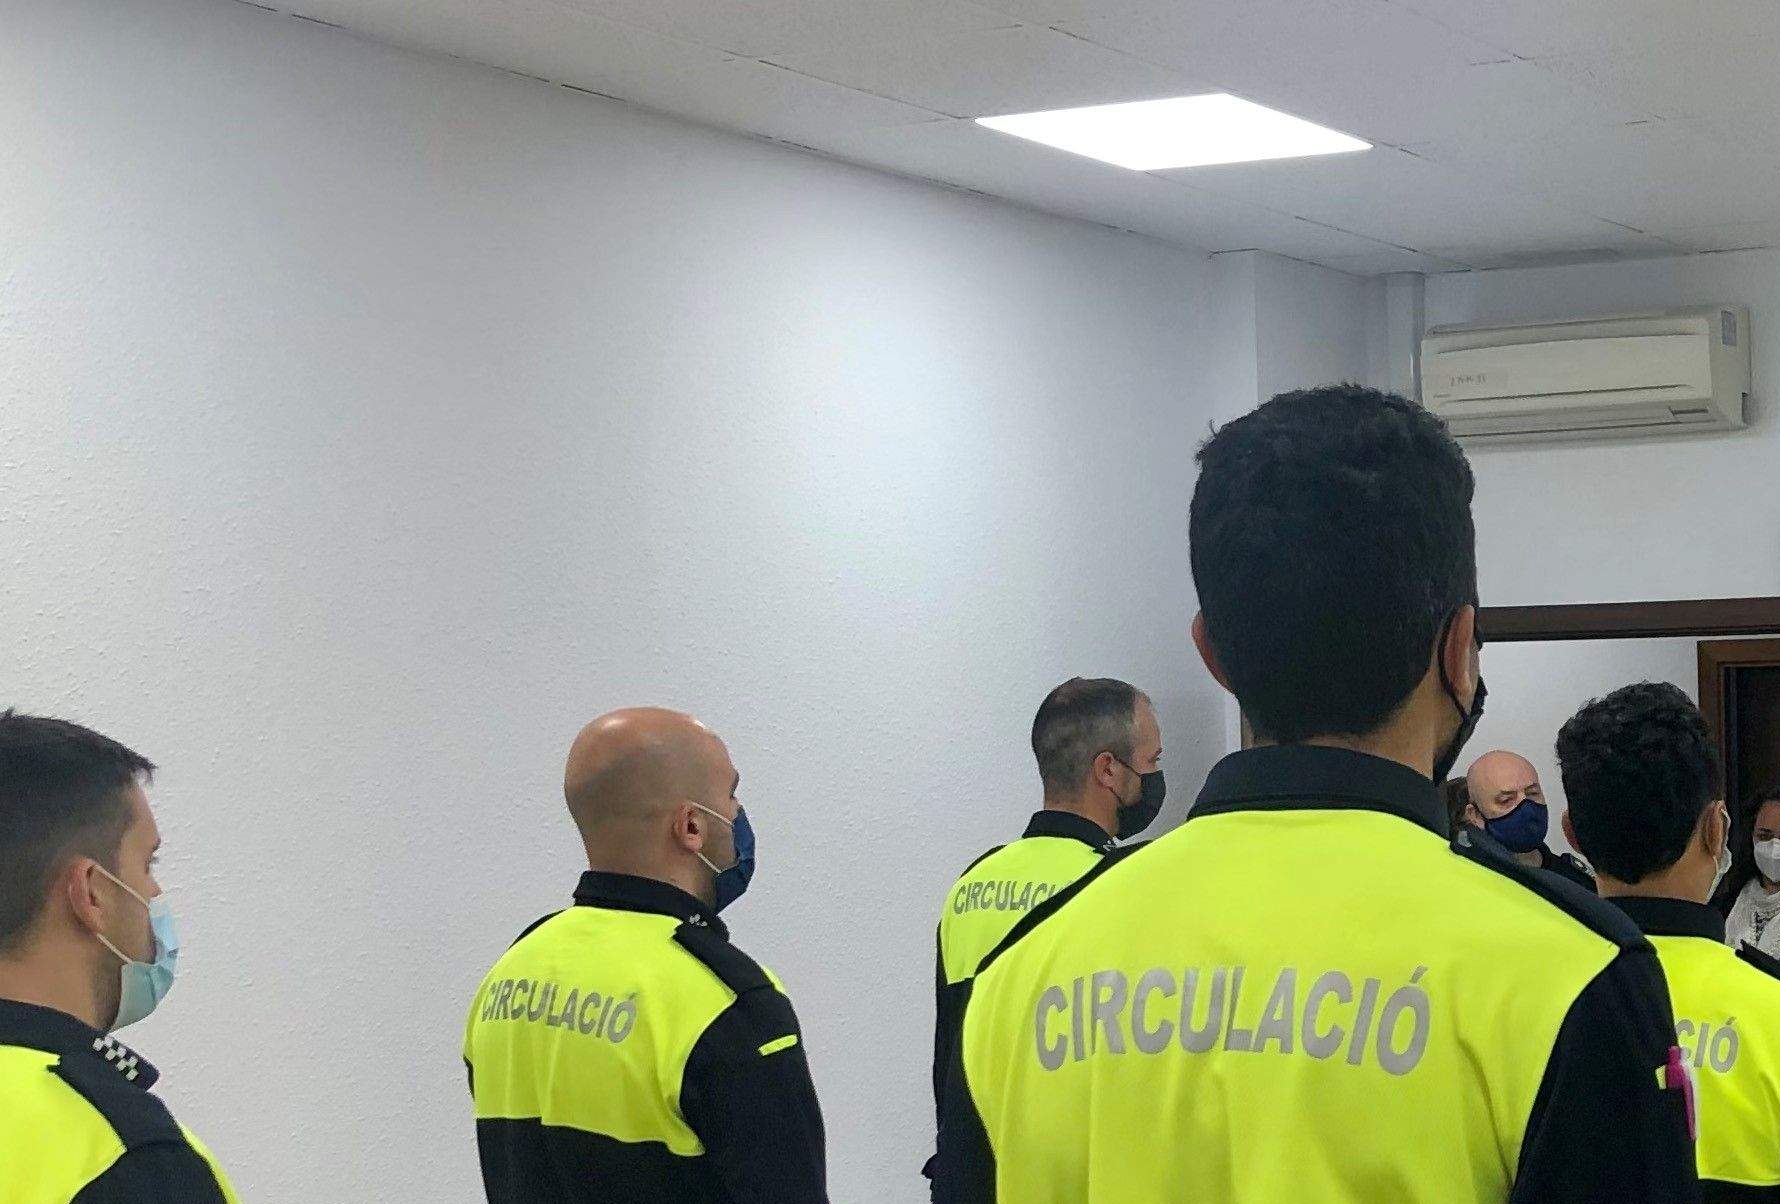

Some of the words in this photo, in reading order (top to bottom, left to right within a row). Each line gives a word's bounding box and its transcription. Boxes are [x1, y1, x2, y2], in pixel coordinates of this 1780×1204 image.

[953, 880, 1072, 914] CIRCULAC
[482, 978, 638, 1043] CIRCULACIÓ
[1035, 965, 1430, 1076] CIRCULACIÓ
